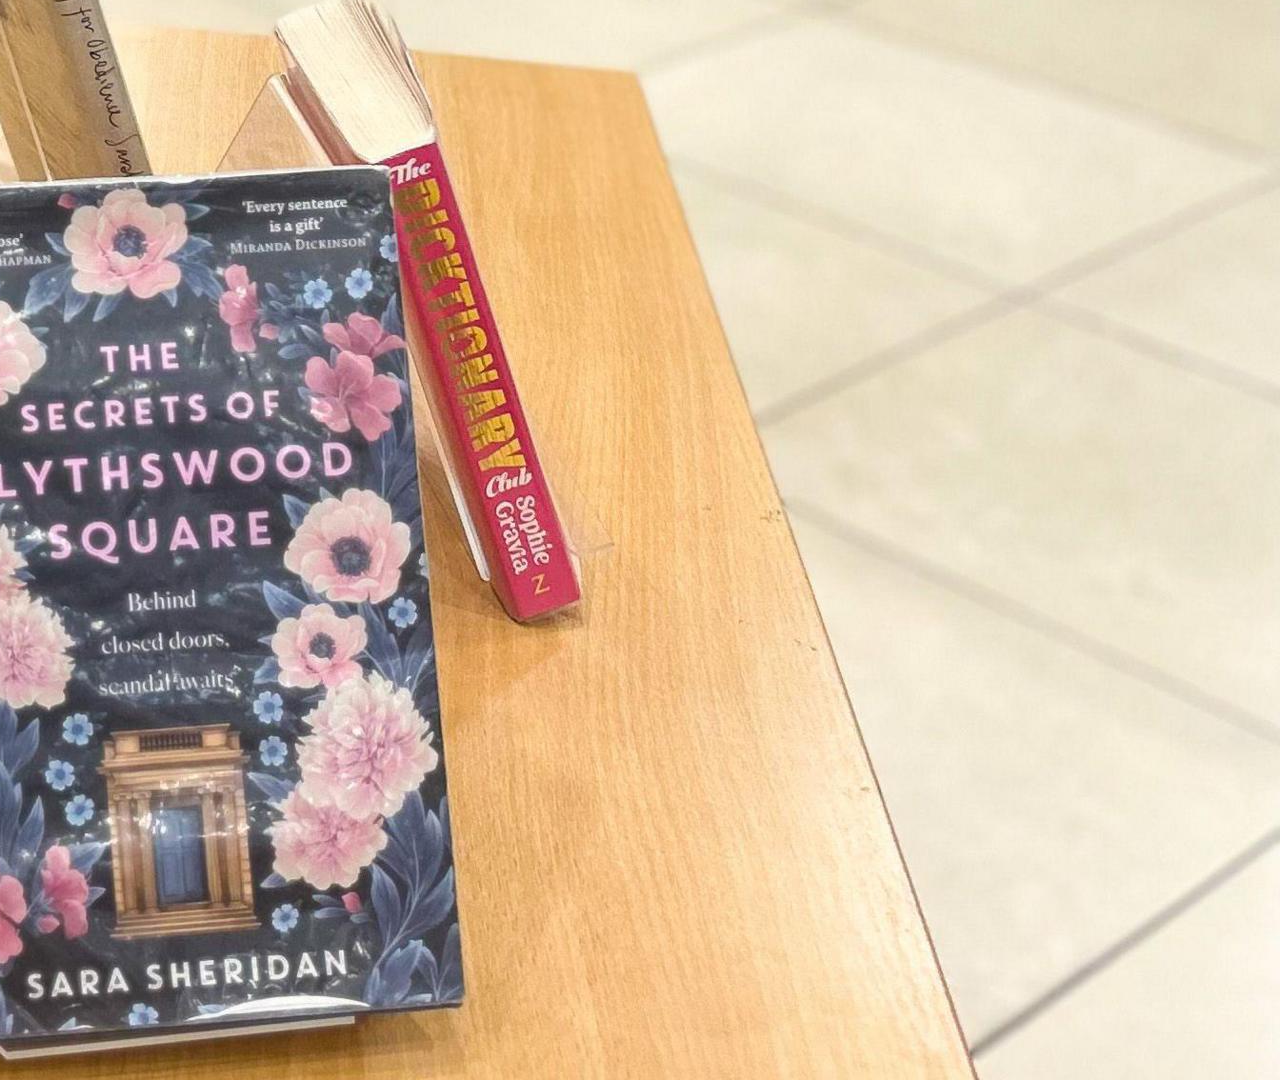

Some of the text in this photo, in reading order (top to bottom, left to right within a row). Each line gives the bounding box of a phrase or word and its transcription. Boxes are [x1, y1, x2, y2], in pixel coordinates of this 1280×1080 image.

[61, 6, 95, 33] for
[388, 157, 432, 185] The
[242, 199, 348, 215] 'Every sentence
[269, 217, 324, 235] is a gift'
[393, 178, 527, 472] DICKTIONARY
[99, 342, 180, 373] THE
[20, 389, 280, 433] SECRETS OF
[486, 466, 533, 498] Club
[48, 510, 273, 564] SQUARE
[495, 501, 529, 575] Gravia
[515, 495, 553, 566] Sophie
[128, 589, 197, 612] Behind
[101, 632, 164, 654] closed
[98, 673, 170, 696] scandal
[27, 949, 348, 999] SARA SHERIDAN
